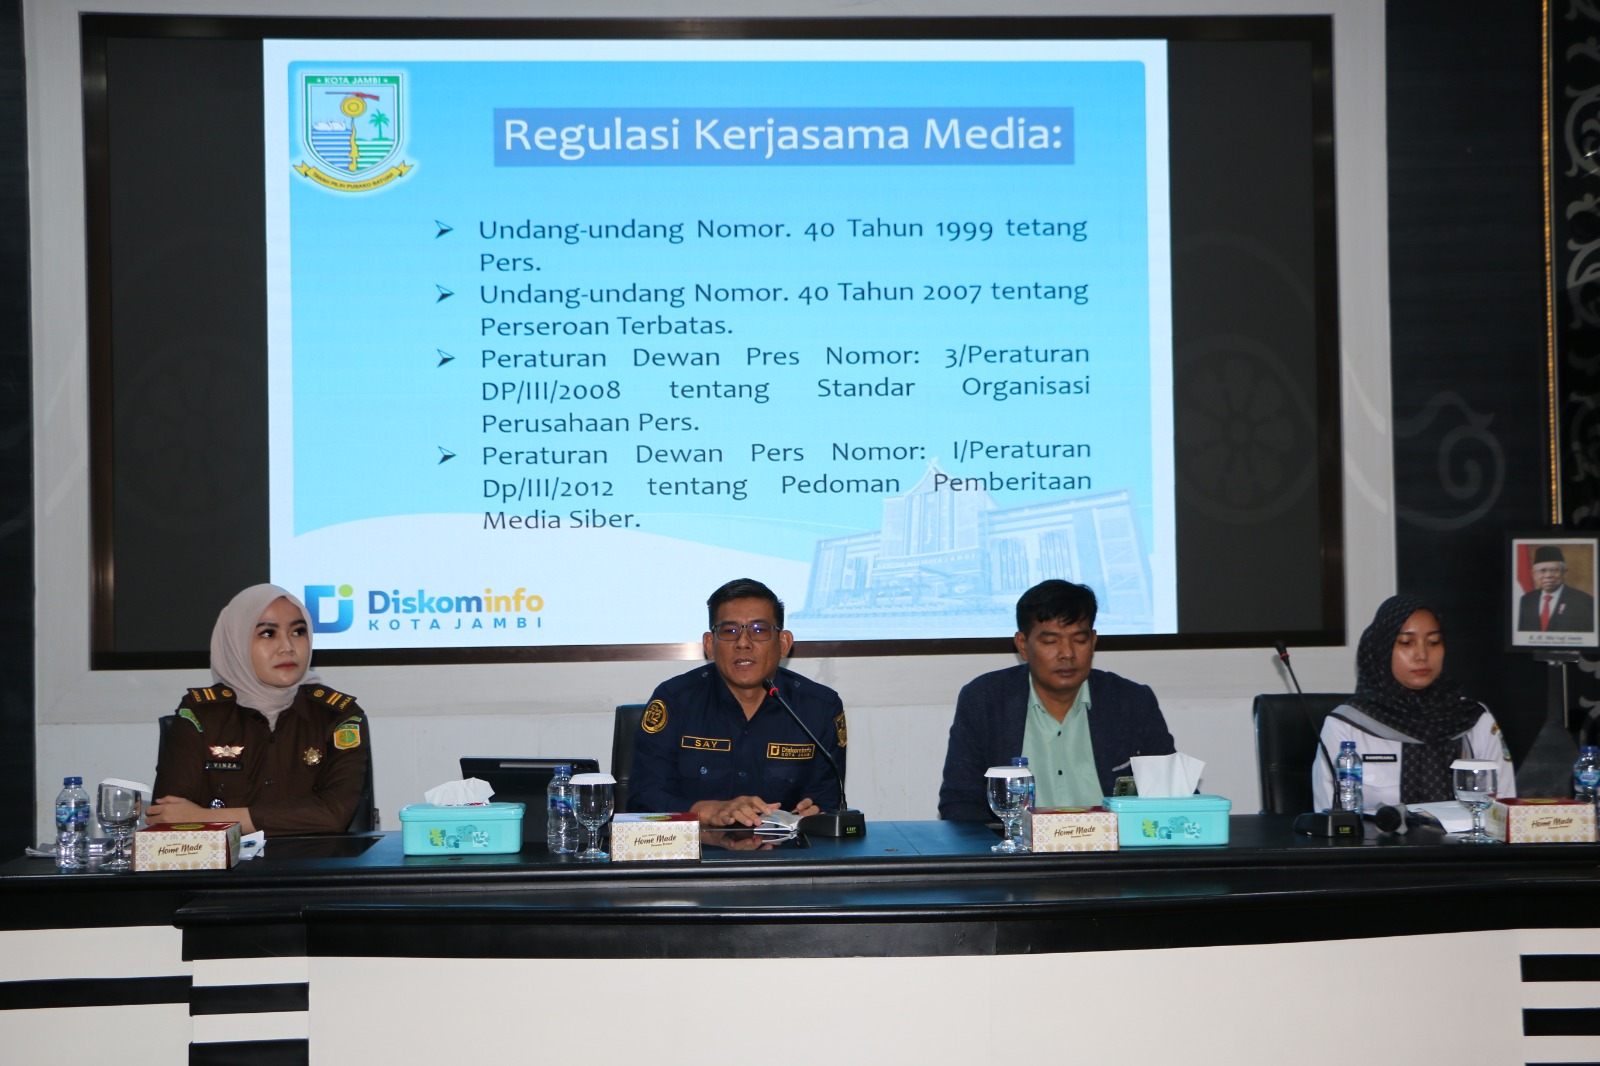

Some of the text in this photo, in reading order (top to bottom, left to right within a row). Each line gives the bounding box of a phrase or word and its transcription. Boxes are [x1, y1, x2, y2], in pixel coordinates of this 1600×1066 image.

[324, 77, 381, 85] KOTA JAMBI
[505, 117, 1062, 160] Regulasi Kerjasama Media:
[479, 217, 1088, 245] Undang-undang Nomor. 40 Tahun 1999 tetang
[480, 253, 541, 272] Pers.
[480, 280, 1089, 310] Undang-undang Nomor. 40 Tahun 2007 tentang
[481, 314, 733, 337] Perseroan Terbatas.
[481, 343, 1089, 369] Peraturan Dewan Pres Nomor: 3/Peraturan
[482, 375, 1090, 405] DP/III/2008 tentang Standar Organisasi
[482, 412, 699, 434] Perusahaan Pers.
[482, 446, 608, 466] Peraturan
[636, 444, 723, 464] Dewan
[751, 443, 805, 462] Pers
[832, 442, 926, 461] Nomor:
[483, 470, 1092, 504] Dp/III/2012 tentang Pedoman Pemberitaan
[483, 508, 641, 530] Media Siber.
[368, 587, 544, 615] Diskominfo
[368, 617, 542, 631] KOTA JAMBI
[694, 739, 718, 749] SAY
[1053, 829, 1074, 838] Home
[1075, 825, 1096, 835] Made
[1531, 820, 1552, 829] Home
[1552, 816, 1574, 826] Made
[157, 843, 203, 856] Home Made
[633, 836, 655, 847] Home
[656, 833, 677, 843] Made
